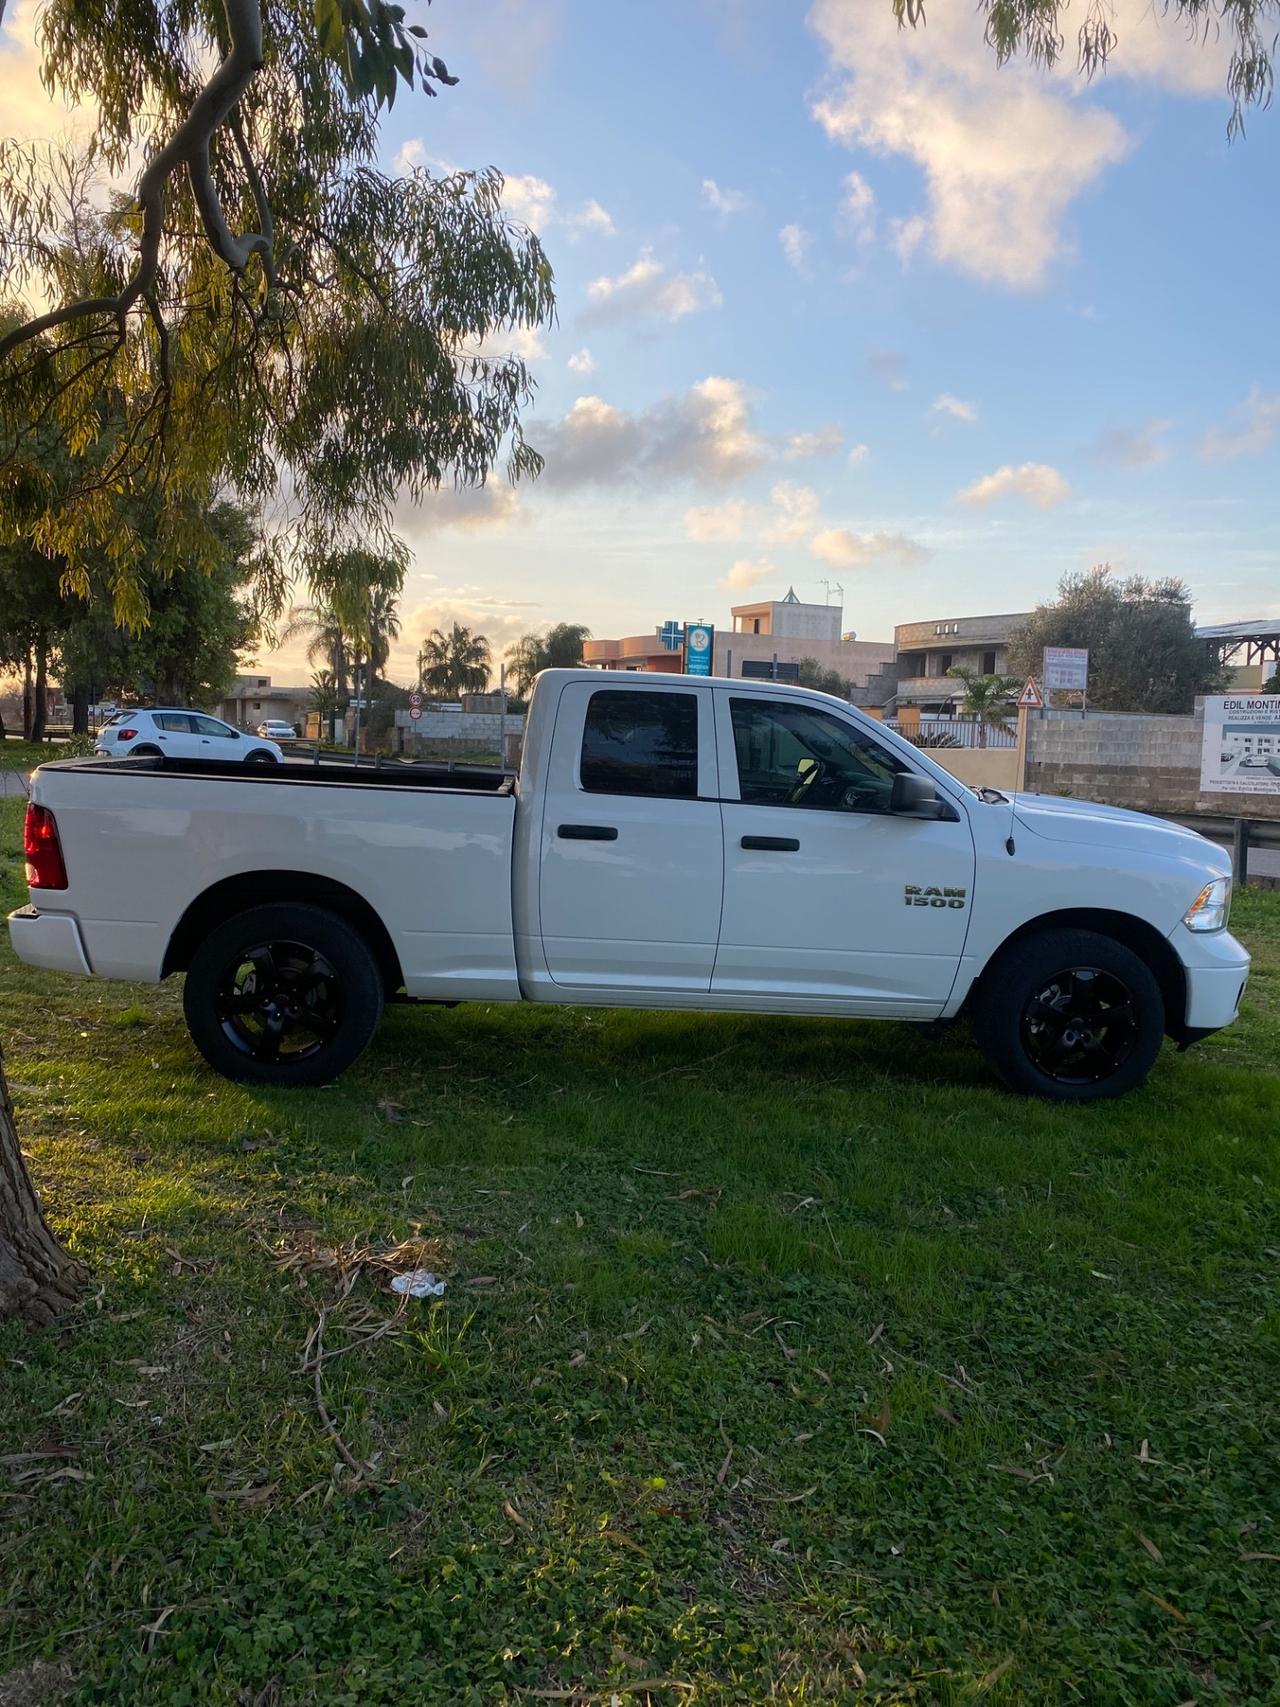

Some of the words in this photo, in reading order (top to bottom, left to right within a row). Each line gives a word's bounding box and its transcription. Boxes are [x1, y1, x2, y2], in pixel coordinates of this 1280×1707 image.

[1224, 700, 1244, 710] EDIL
[905, 885, 966, 897] RAM
[904, 896, 965, 909] 1500
